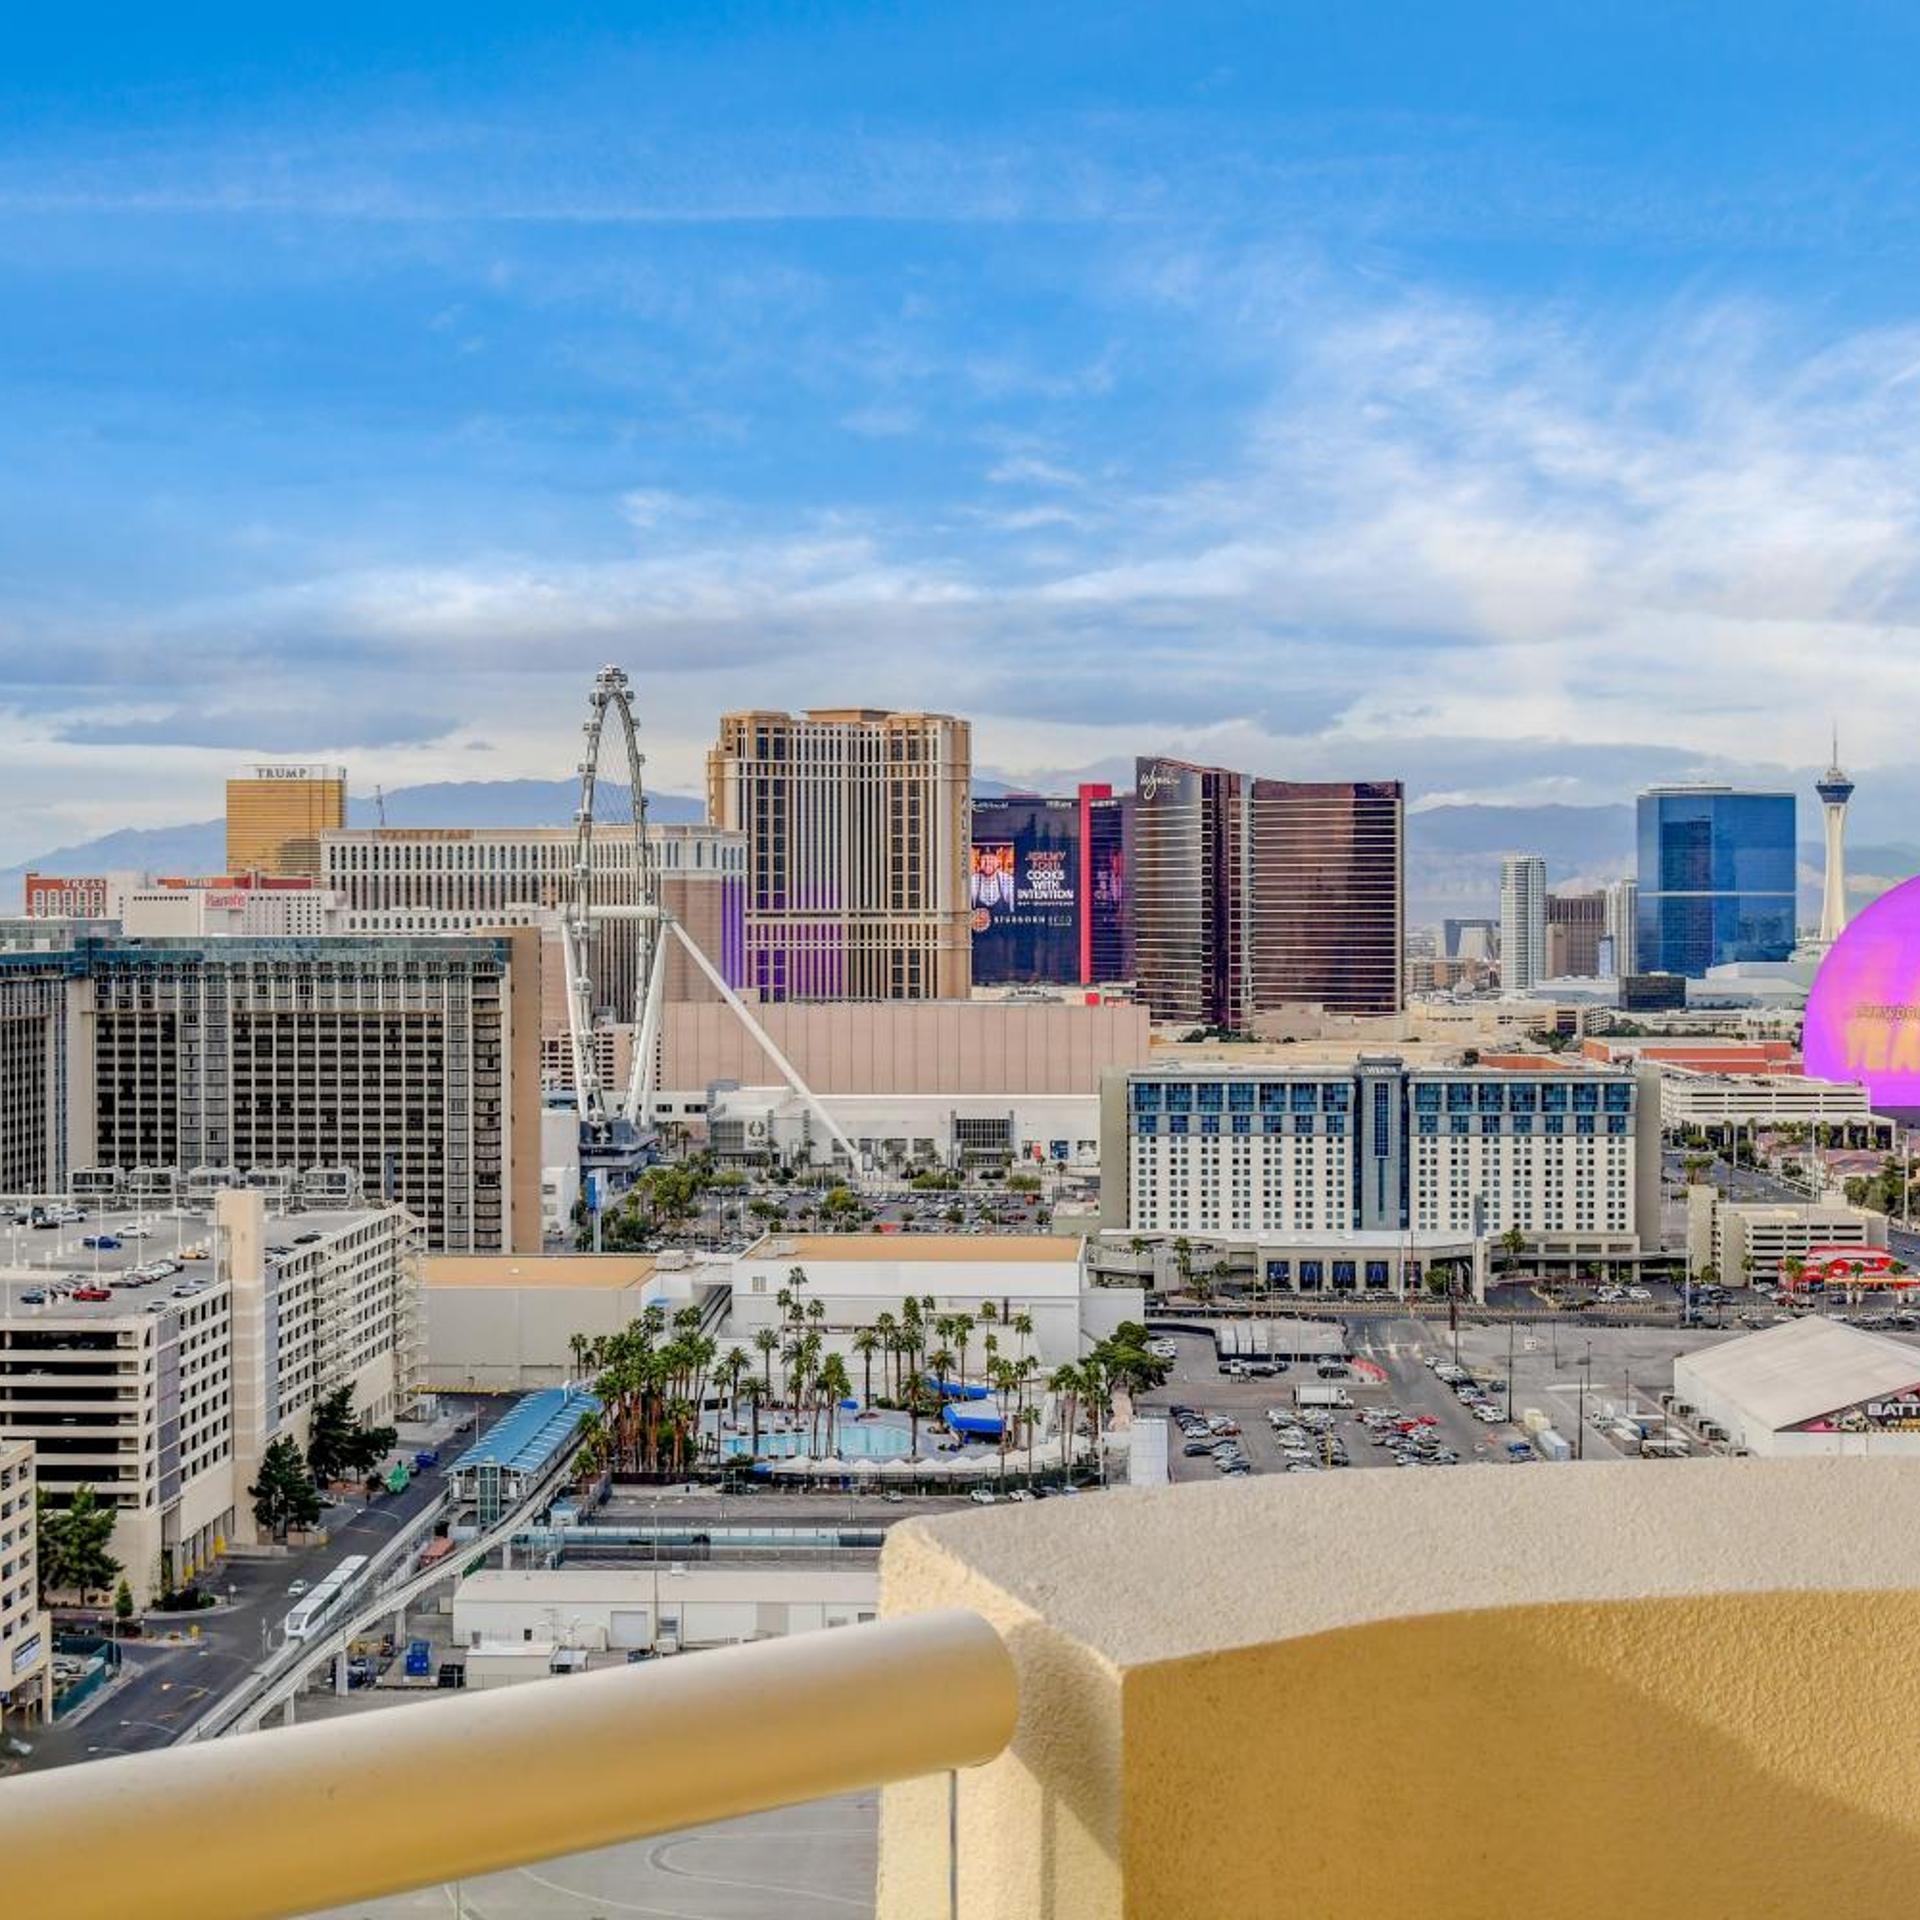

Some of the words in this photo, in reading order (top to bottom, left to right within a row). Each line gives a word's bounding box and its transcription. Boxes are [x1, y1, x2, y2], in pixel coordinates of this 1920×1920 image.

[256, 768, 307, 778] TRUMP
[1026, 870, 1065, 880] COOKS
[1033, 880, 1060, 890] WITH
[1017, 889, 1074, 899] INTENTION
[1868, 1403, 1920, 1416] BATT
